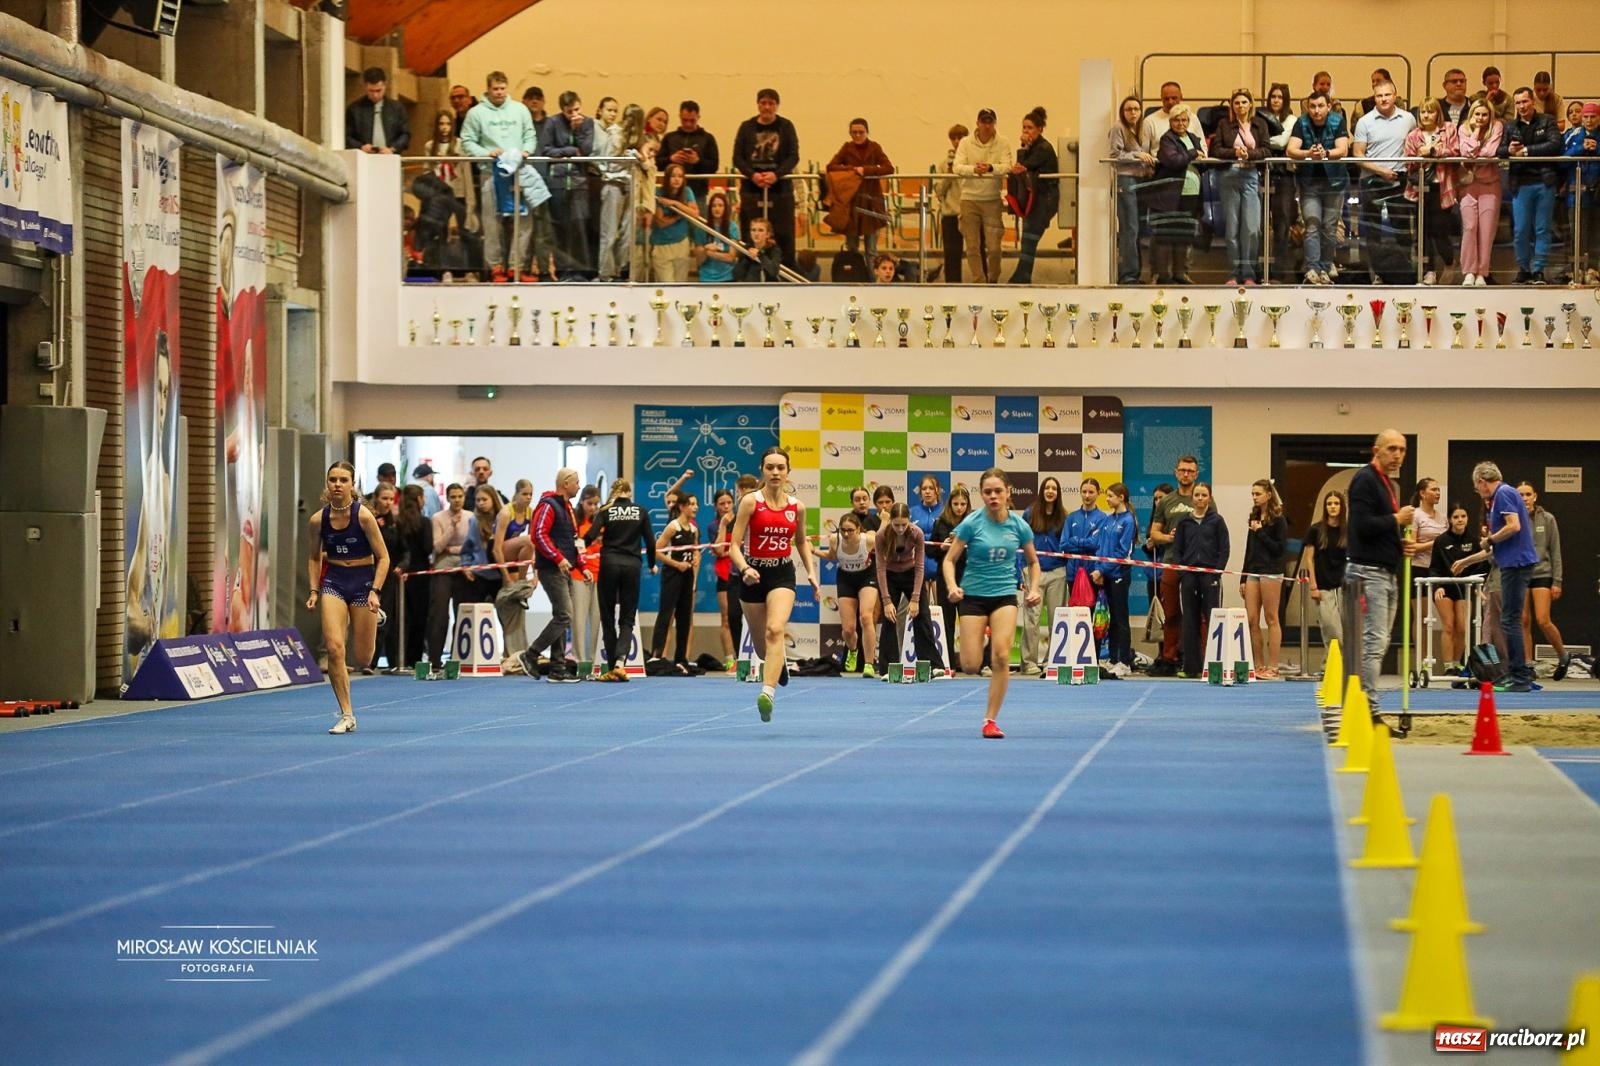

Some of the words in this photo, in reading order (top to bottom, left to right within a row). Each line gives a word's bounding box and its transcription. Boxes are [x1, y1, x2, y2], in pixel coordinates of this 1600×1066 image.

[797, 405, 818, 413] ZSOMS
[608, 506, 640, 516] SMS
[758, 535, 788, 551] 758
[760, 558, 780, 567] PRO
[457, 617, 472, 660] 6
[479, 617, 495, 660] 6
[1053, 621, 1069, 664] 2
[1075, 621, 1092, 664] 2
[1212, 622, 1224, 661] 1
[1233, 622, 1245, 661] 1
